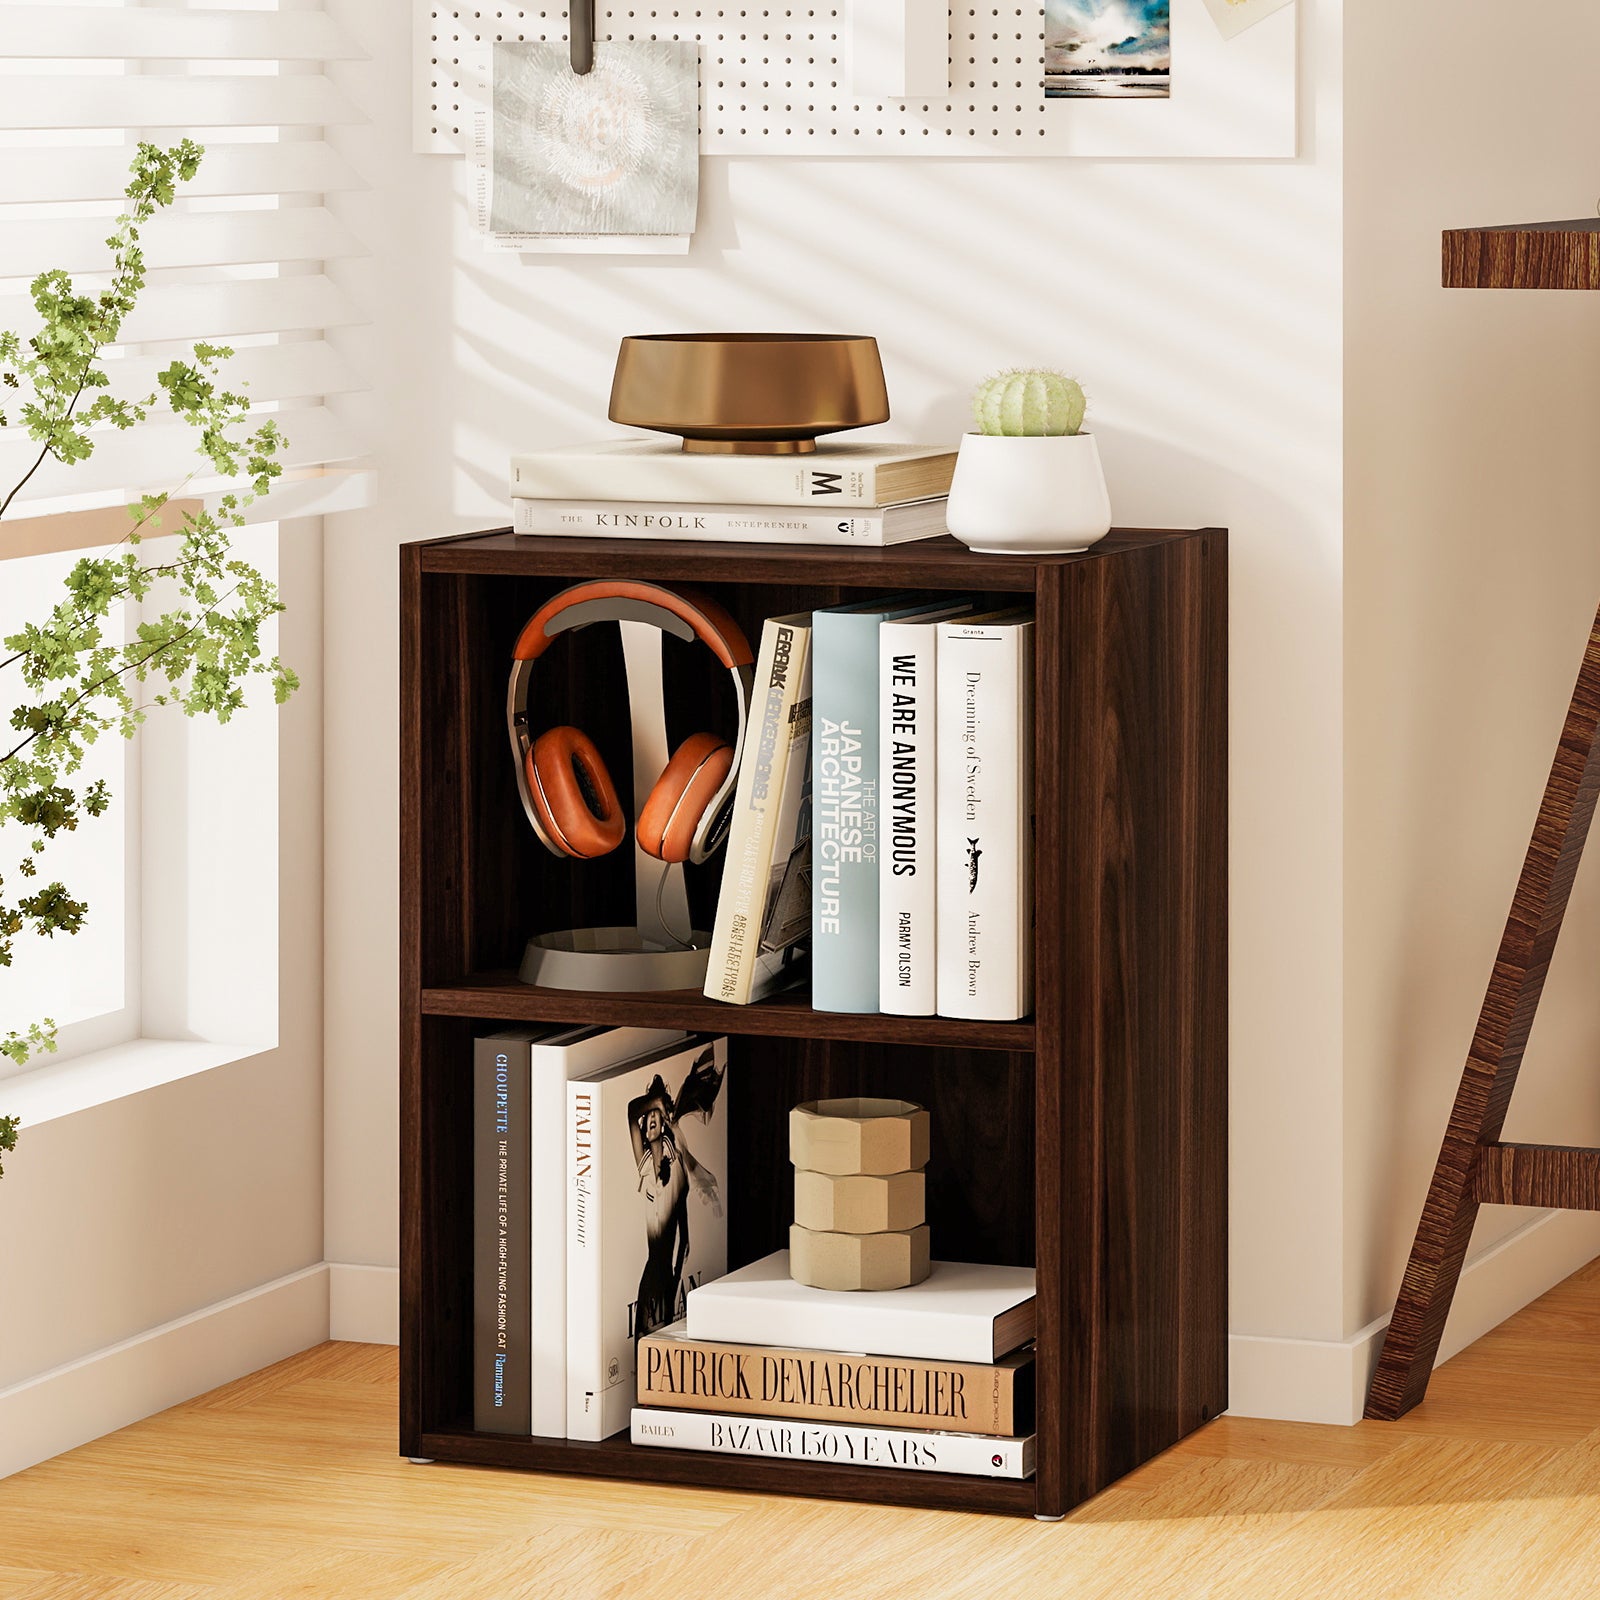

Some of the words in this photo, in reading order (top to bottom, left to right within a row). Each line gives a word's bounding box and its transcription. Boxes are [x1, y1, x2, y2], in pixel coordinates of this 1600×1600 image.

[812, 472, 842, 495] M
[596, 514, 706, 529] KINFOLK
[727, 520, 808, 530] ENTEPRENEUR
[770, 628, 793, 689] FRANK
[893, 655, 915, 686] WE
[893, 693, 915, 735] ARE
[963, 673, 980, 742] Dreaming
[967, 747, 980, 762] of
[838, 721, 862, 865] JAPANESE
[861, 779, 875, 807] THE
[893, 741, 916, 876] ANONYMOUS
[967, 765, 981, 820] Sweden
[820, 718, 840, 934] ARCHITECTURE
[861, 811, 875, 840] ART
[863, 844, 875, 863] OF
[899, 913, 910, 949] PARMY
[969, 913, 980, 953] Andrew
[721, 914, 741, 997] CONSTRUCTIONS
[728, 915, 747, 997] ARCHITECTURAL
[899, 953, 911, 986] OLSON
[969, 961, 980, 996] Brown
[497, 1054, 507, 1132] CHOUPETTE
[498, 1141, 508, 1156] THE
[576, 1095, 591, 1177] ITALIAN
[498, 1159, 508, 1193] PRIVATE
[498, 1195, 508, 1214] LIFE
[498, 1215, 508, 1228] OF
[572, 1177, 589, 1248] glamour
[498, 1238, 508, 1292] HIGH-FLYING
[497, 1294, 507, 1330] FASHION
[497, 1332, 507, 1349] CAT
[495, 1354, 505, 1406] Flammarion
[646, 1347, 752, 1399] PATRICK
[760, 1355, 969, 1421] DEMARCHELIER
[641, 1424, 675, 1437] BAILEY
[711, 1422, 791, 1455] BAZAAR
[802, 1431, 837, 1456] 150
[844, 1436, 938, 1467] YEARS
